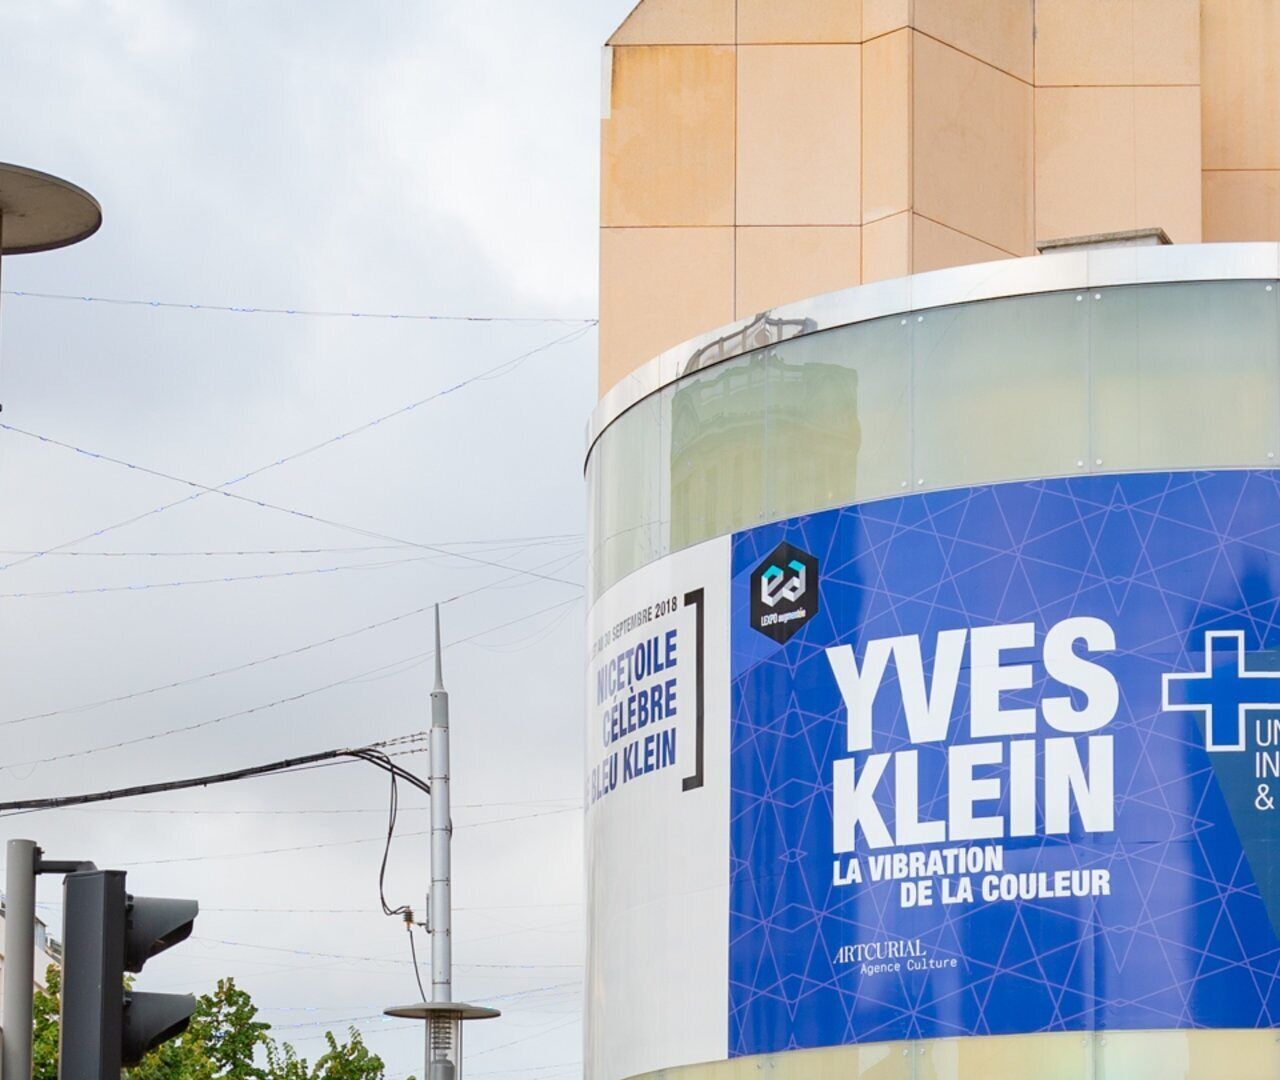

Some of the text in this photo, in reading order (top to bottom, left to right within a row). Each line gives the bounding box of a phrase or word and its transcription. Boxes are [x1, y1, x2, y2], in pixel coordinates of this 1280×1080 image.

[612, 605, 653, 642] SEPTEMBRE
[655, 596, 678, 620] 2018
[597, 628, 678, 706] NICETOILE
[825, 615, 1120, 752] YVES
[603, 677, 677, 748] CÉLÈBRE
[590, 752, 618, 806] BLEU
[623, 727, 677, 784] KLEIN
[833, 734, 1114, 854] KLEIN
[1254, 783, 1275, 810] &
[832, 845, 1004, 886] LA VIBRATION
[900, 868, 1111, 908] DE LA COULEUR
[833, 938, 927, 964] ARTCURIAL
[860, 957, 958, 977] Agence Culture
